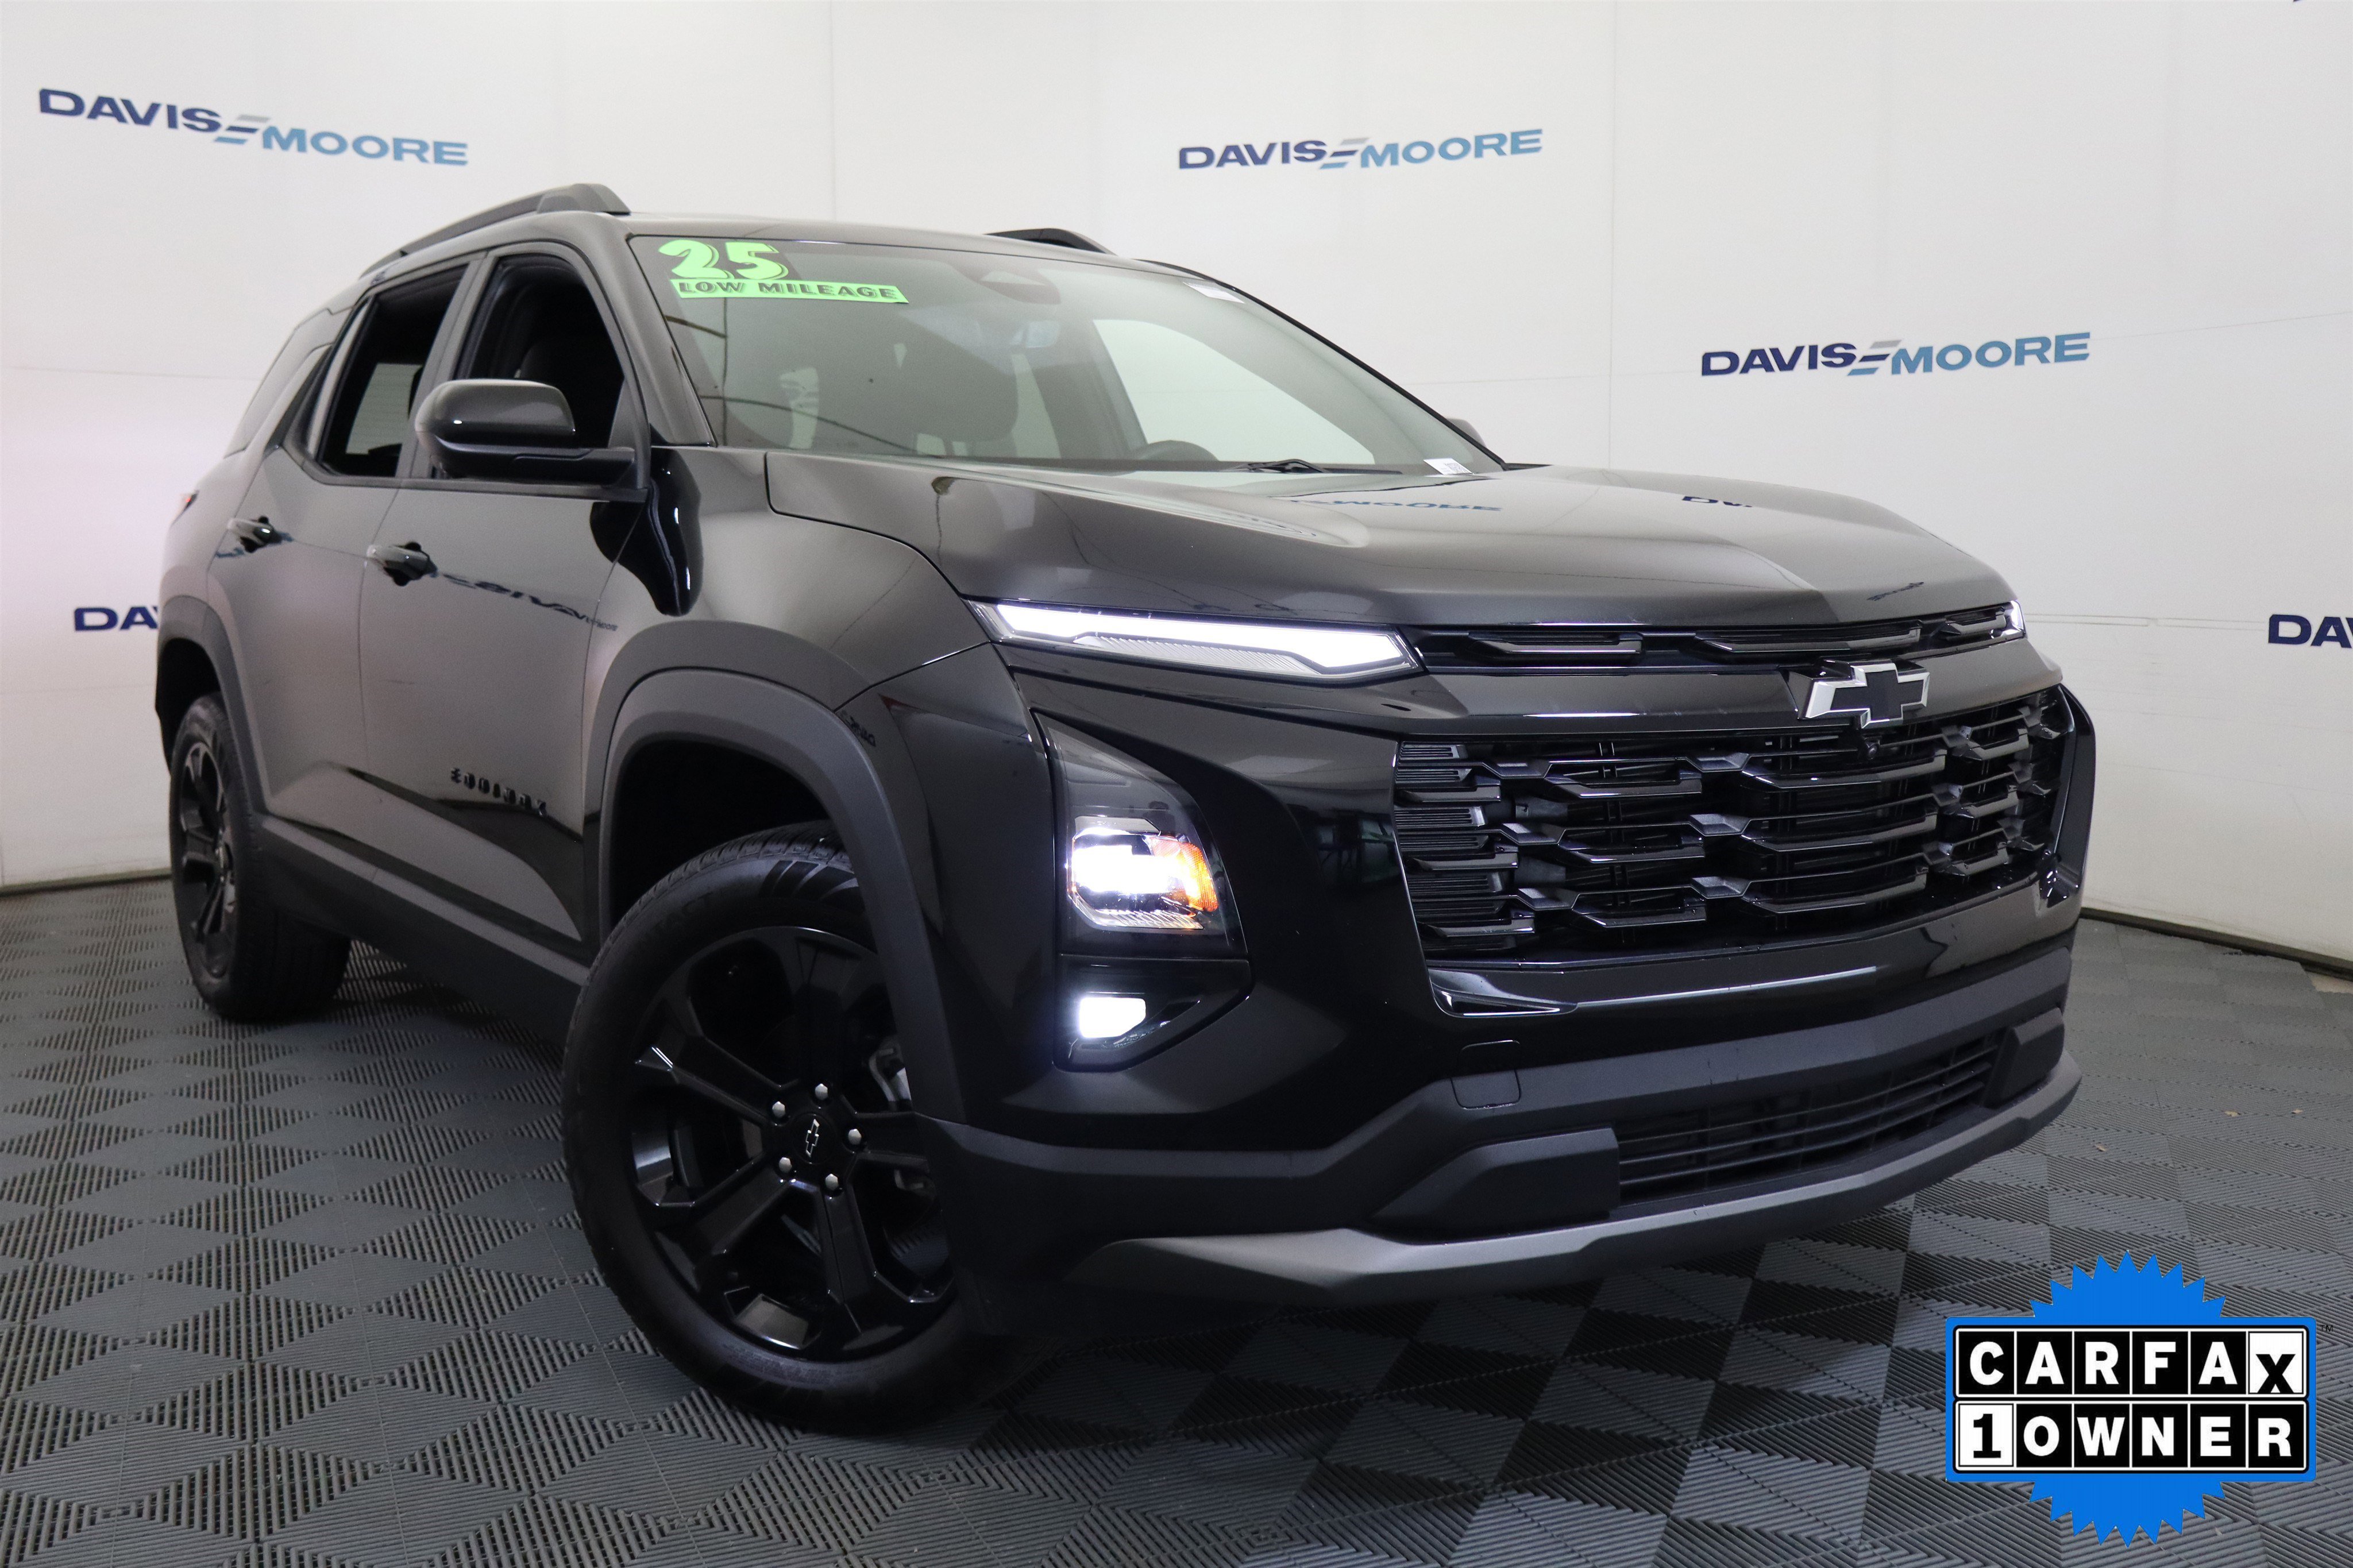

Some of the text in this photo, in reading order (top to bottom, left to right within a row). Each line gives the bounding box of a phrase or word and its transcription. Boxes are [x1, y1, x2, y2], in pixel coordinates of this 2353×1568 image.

[39, 88, 468, 166] DAVIS MOORE
[1179, 129, 1543, 169] DAVIS MOORE
[658, 240, 789, 280] 25
[678, 281, 898, 299] LOW MILEAGE
[1702, 331, 2090, 377] DAVIS MOORE
[74, 607, 158, 631] DA
